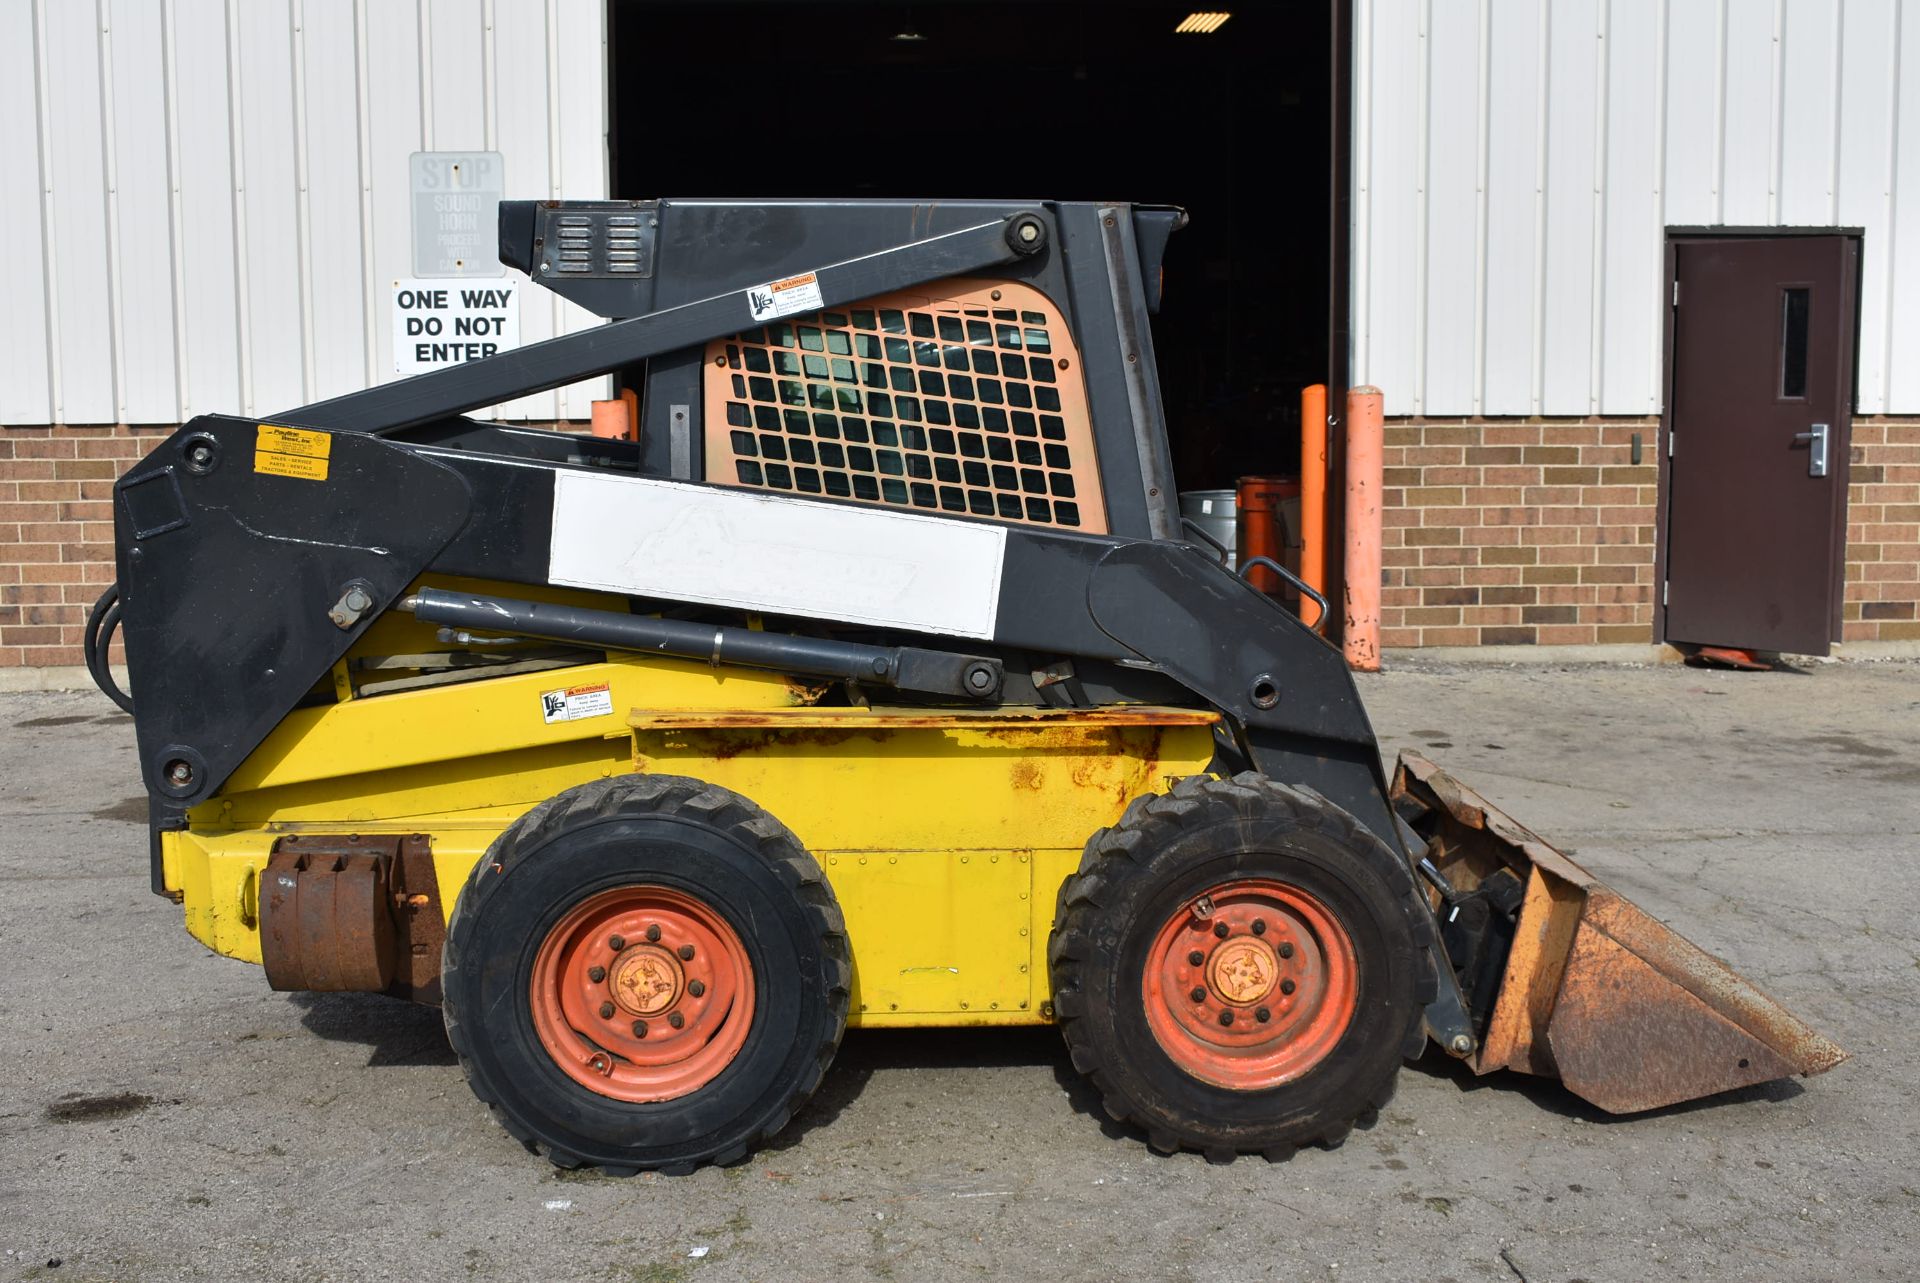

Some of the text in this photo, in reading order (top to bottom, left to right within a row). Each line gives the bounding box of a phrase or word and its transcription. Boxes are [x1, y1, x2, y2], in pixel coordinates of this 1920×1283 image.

[422, 158, 491, 189] STOP
[433, 194, 482, 212] SOUND
[440, 213, 478, 231] HORN
[782, 276, 812, 287] WARNING
[397, 290, 512, 309] ONE WAY
[407, 317, 506, 336] DO NOT
[416, 343, 497, 362] ENTER
[575, 685, 606, 693] WARNING
